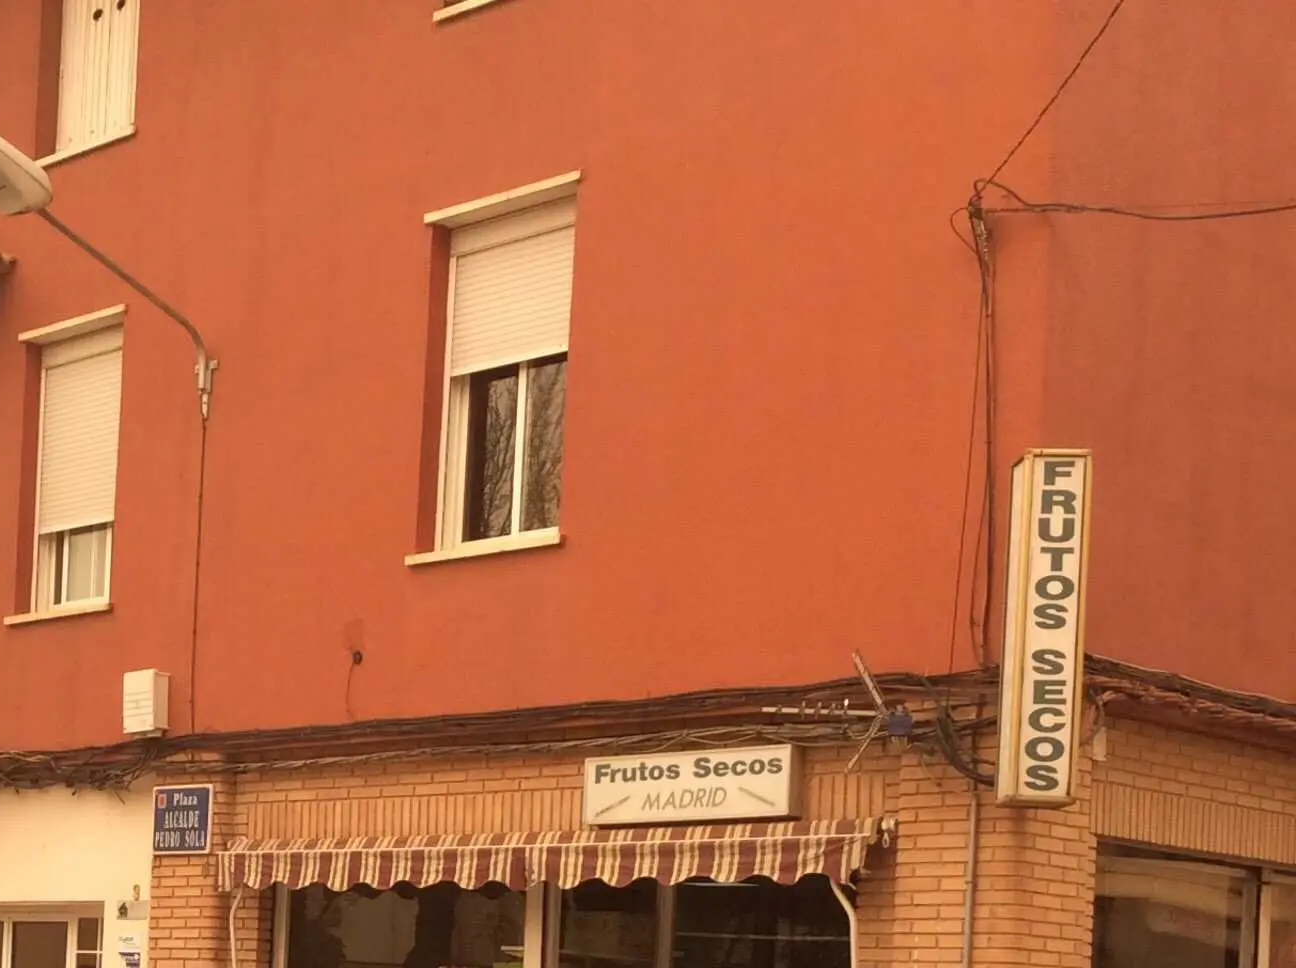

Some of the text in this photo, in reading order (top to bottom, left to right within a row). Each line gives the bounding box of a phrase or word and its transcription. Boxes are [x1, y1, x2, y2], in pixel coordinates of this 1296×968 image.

[1023, 460, 1078, 792] FRUTOS SECOS
[594, 756, 784, 785] Frutos Secos
[173, 791, 198, 806] Plaza
[640, 786, 728, 812] MADRID
[163, 810, 200, 829] ALCALDE
[154, 829, 205, 849] PEDRO SOLA
